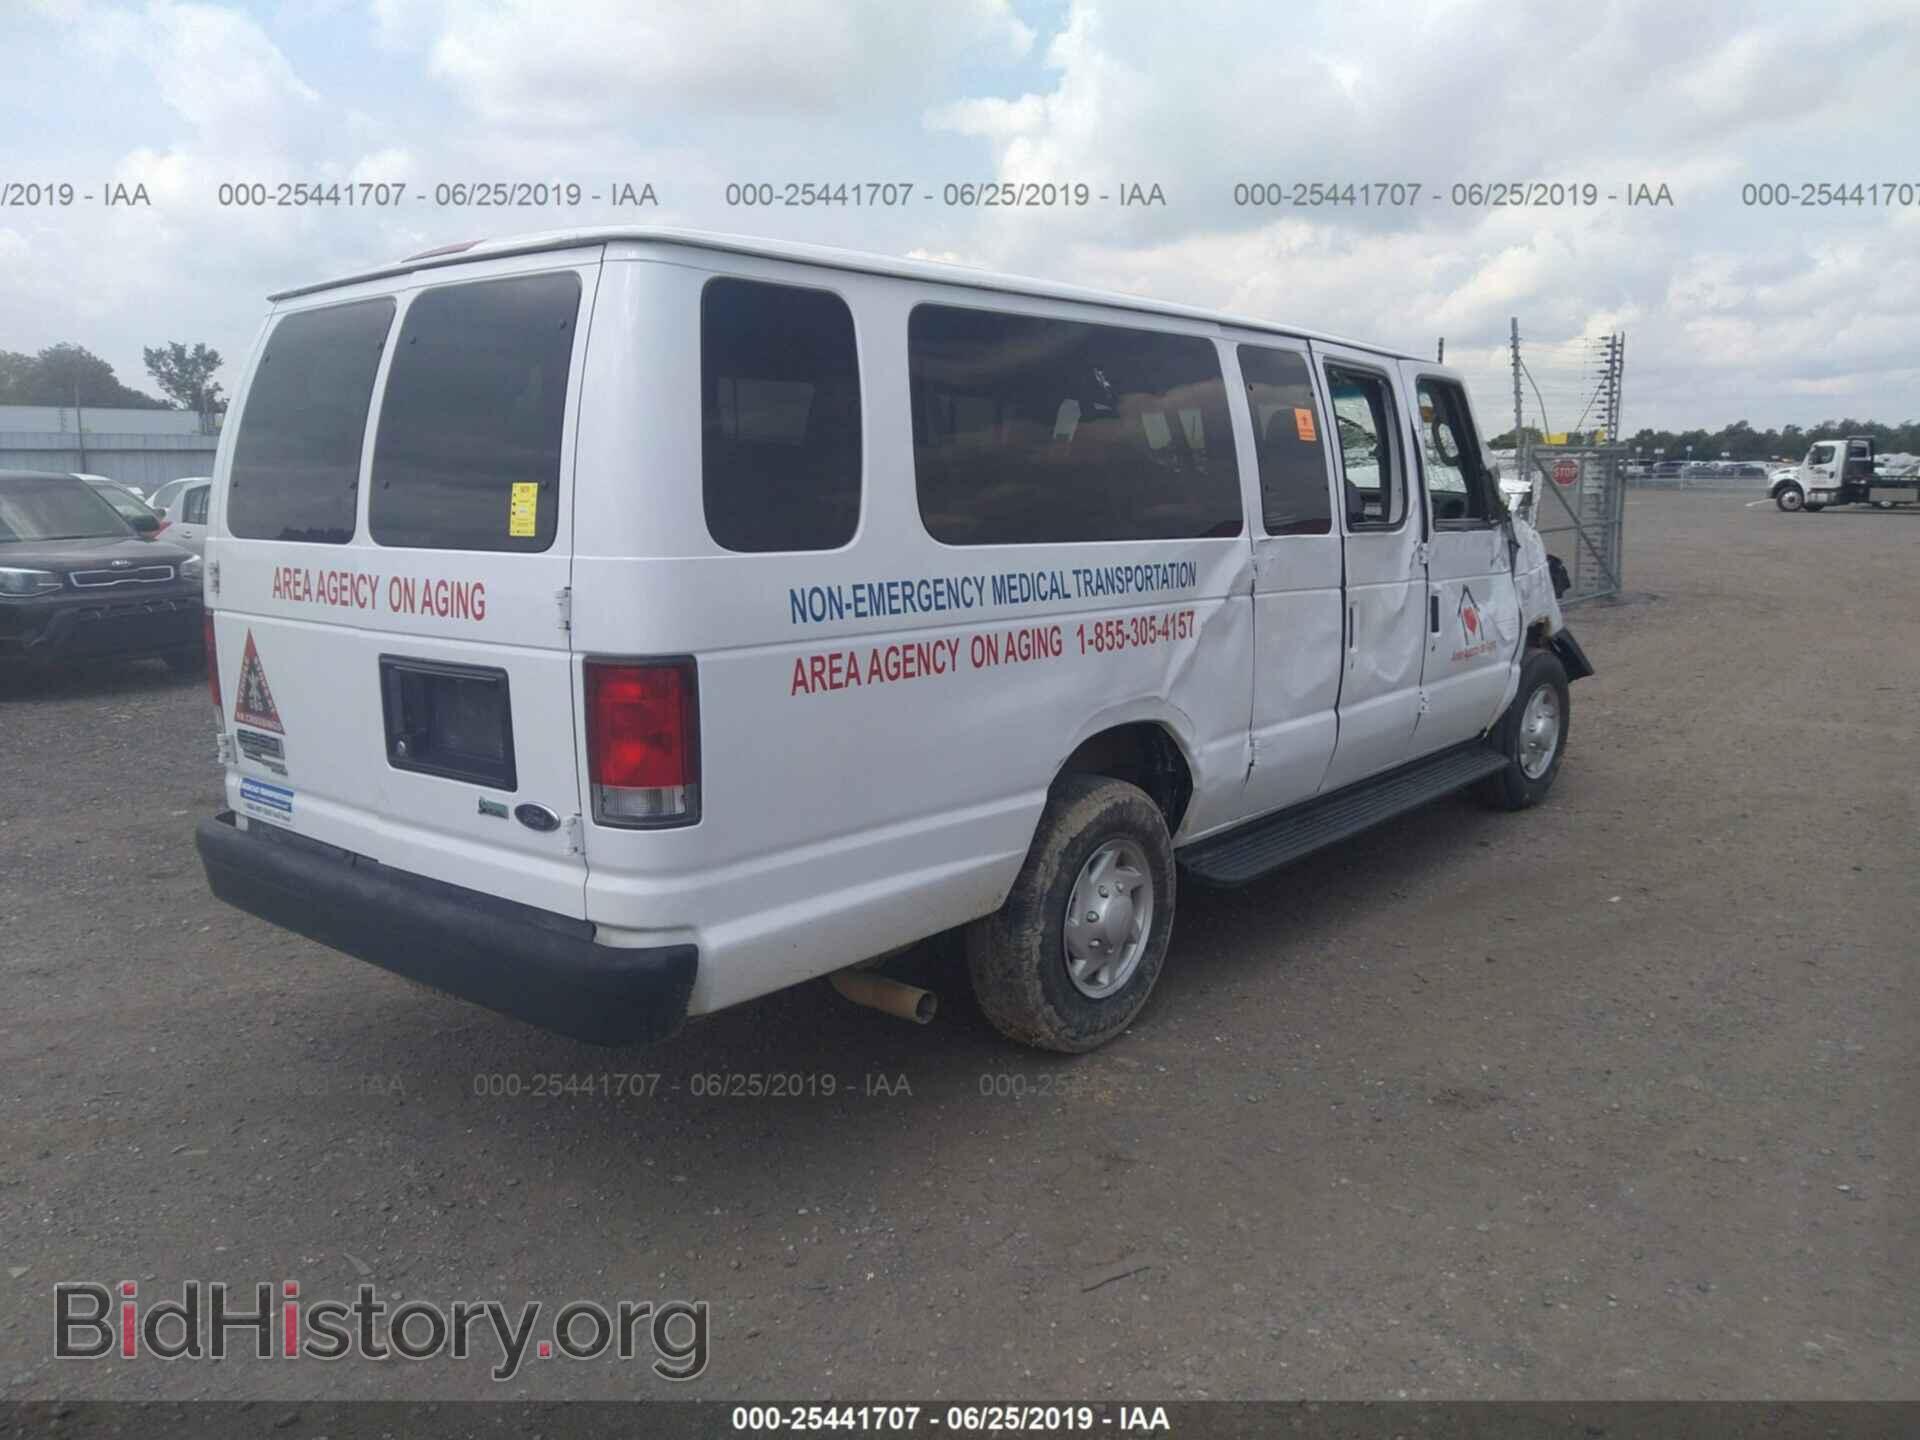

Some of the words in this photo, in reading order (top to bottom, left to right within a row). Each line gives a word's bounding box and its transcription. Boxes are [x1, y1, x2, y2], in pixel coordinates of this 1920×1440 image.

[1553, 466, 1577, 479] STOP
[273, 567, 312, 602] AREA
[316, 570, 379, 610] AGENCY
[389, 576, 415, 614] ON
[421, 580, 486, 621] AGING
[790, 576, 985, 624] NON-EMERGENCY
[992, 570, 1071, 606] MEDICAL
[1072, 561, 1197, 599] TRANSPORTATION
[791, 651, 861, 696] AREA
[867, 638, 960, 684] AGENCY
[971, 633, 999, 668] ON
[1004, 626, 1063, 665] AGING
[1076, 611, 1196, 655] 1-855-305-4157
